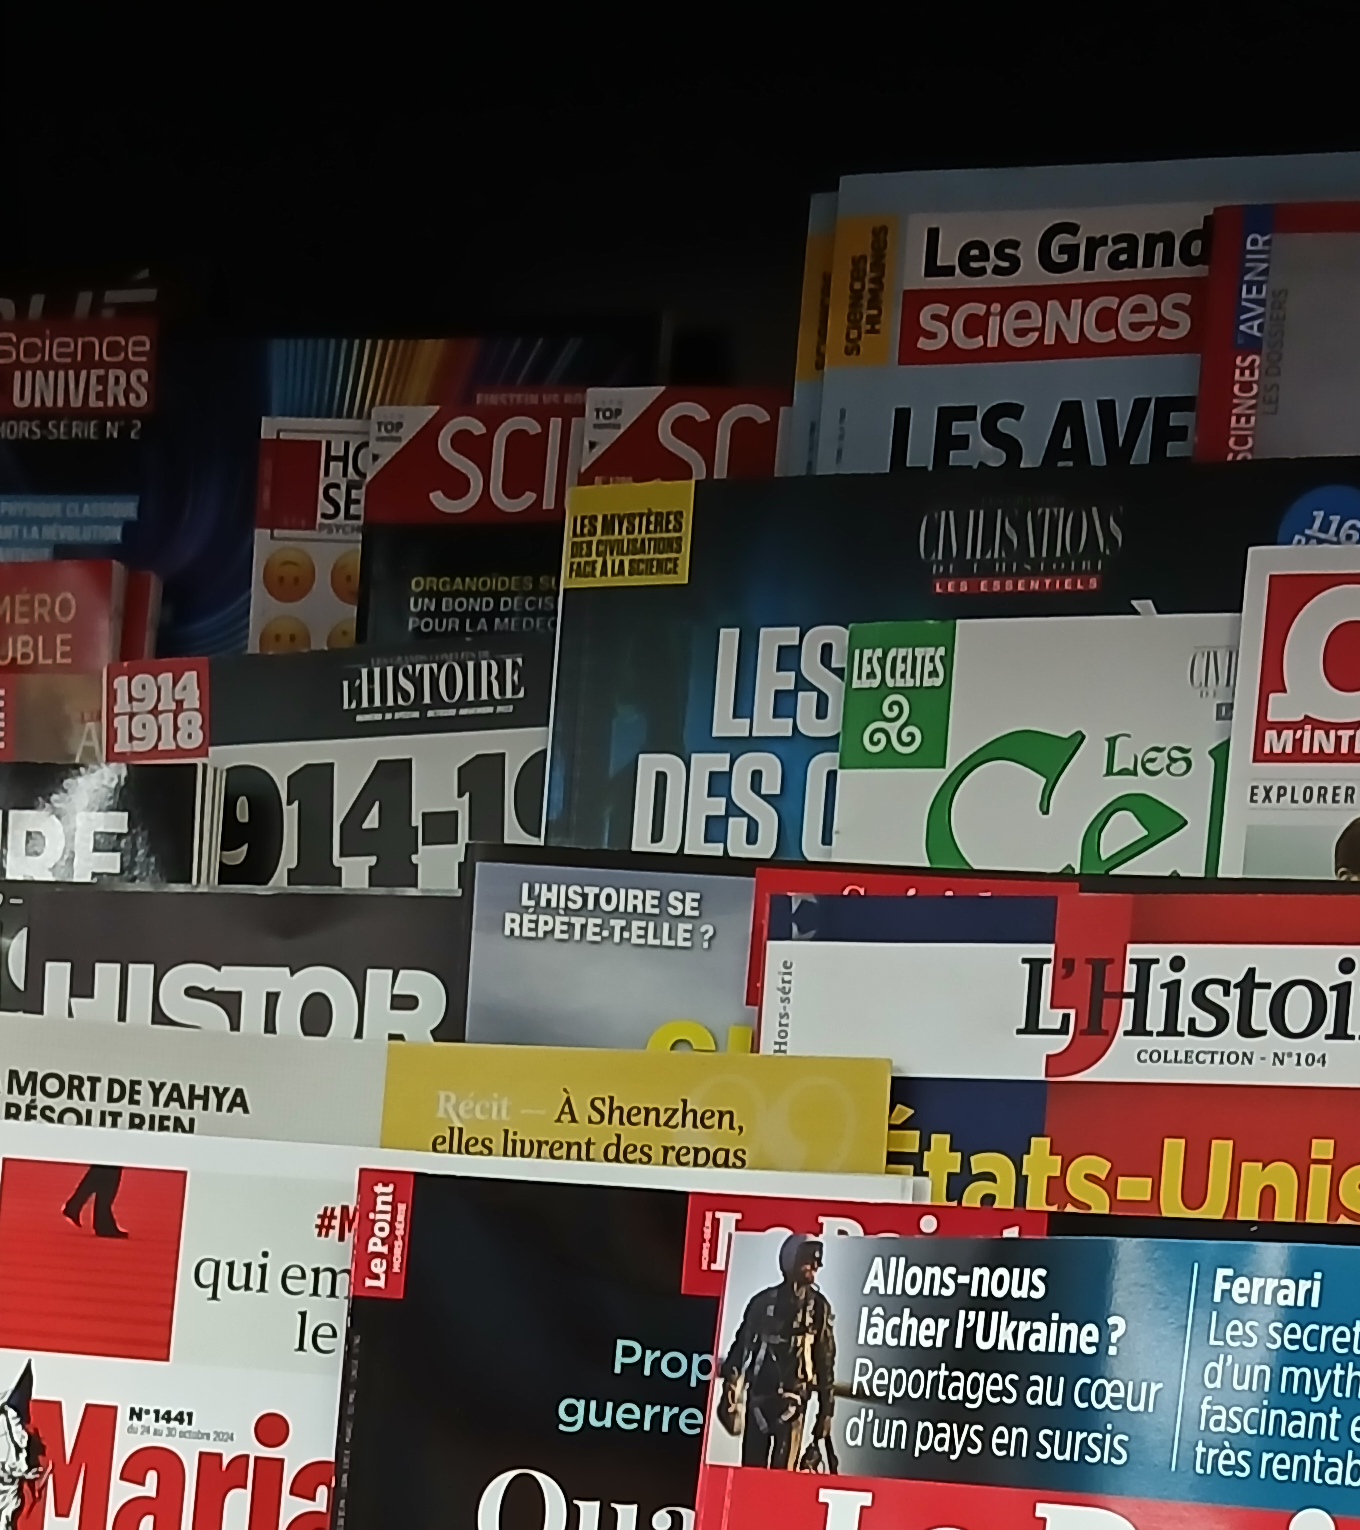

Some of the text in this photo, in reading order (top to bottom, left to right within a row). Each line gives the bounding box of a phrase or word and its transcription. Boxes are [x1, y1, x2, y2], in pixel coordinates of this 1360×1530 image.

[923, 226, 1020, 278] Les
[1238, 232, 1271, 338] AVENIR
[12, 369, 149, 408] UNIVERS
[571, 508, 683, 537] LES MYSTÈRES
[569, 558, 679, 578] FACE LA SCIENCE
[935, 578, 1099, 593] LES ESSENTIELS
[852, 647, 945, 689] LES CELTES
[114, 672, 201, 714] 1914
[114, 711, 204, 753] 1918
[1249, 784, 1356, 806] EXPLORER
[667, 891, 700, 917] SE
[504, 911, 692, 947] RÉPÈTE-T-ELLE
[774, 959, 794, 1056] Hors-série
[1137, 1048, 1254, 1065] COLLECTION
[7, 1070, 102, 1099] MORT
[106, 1076, 143, 1102] DE
[148, 1081, 251, 1115] YAHYA
[554, 1089, 744, 1134] À Shenzhen,
[365, 1182, 394, 1289] Le Point
[863, 1257, 1047, 1298] Allons-nous
[1213, 1268, 1322, 1308] Ferrari
[852, 1358, 1163, 1413] Reportages cœur
[914, 1419, 1129, 1465] pays sursis
